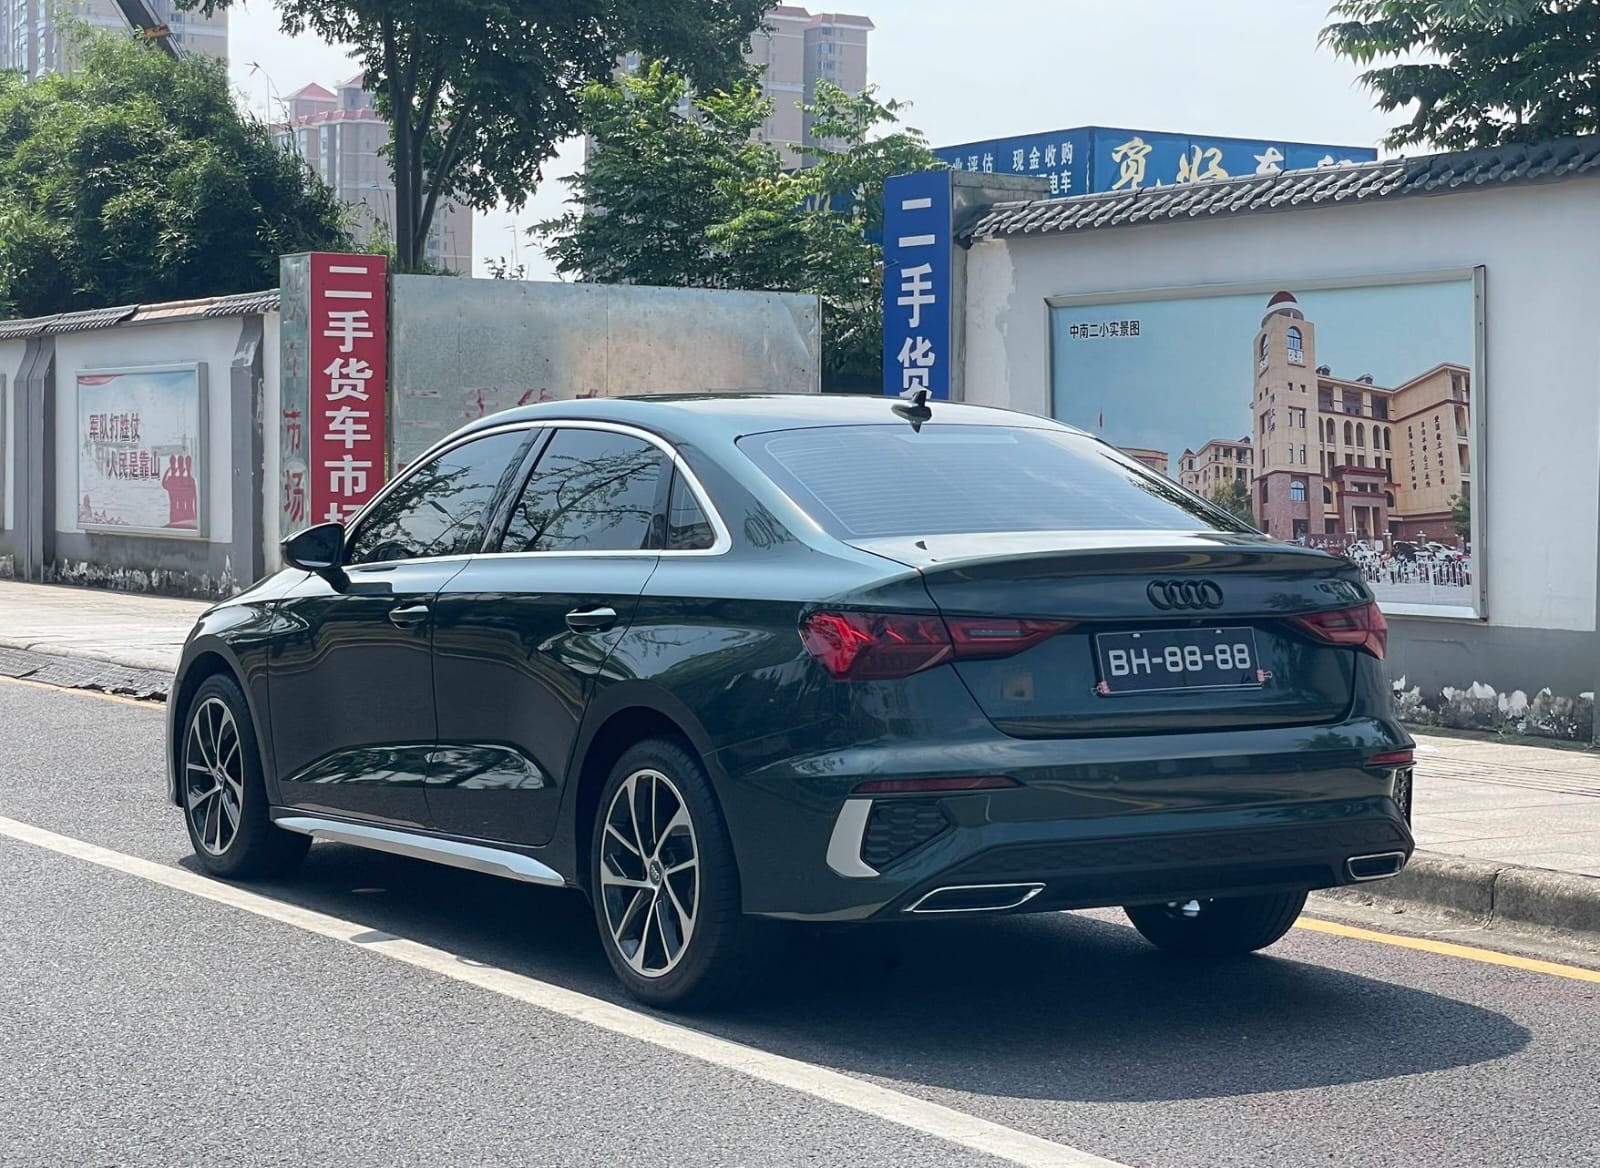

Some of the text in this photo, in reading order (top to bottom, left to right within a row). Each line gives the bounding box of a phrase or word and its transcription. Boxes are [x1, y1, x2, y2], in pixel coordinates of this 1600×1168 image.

[1012, 141, 1073, 172] 现金收购
[1069, 321, 1140, 339] 中南二小实景图
[89, 413, 141, 443] 军队打胜仗
[107, 451, 161, 481] 人民是靠山
[1108, 643, 1251, 676] BH-88-88
